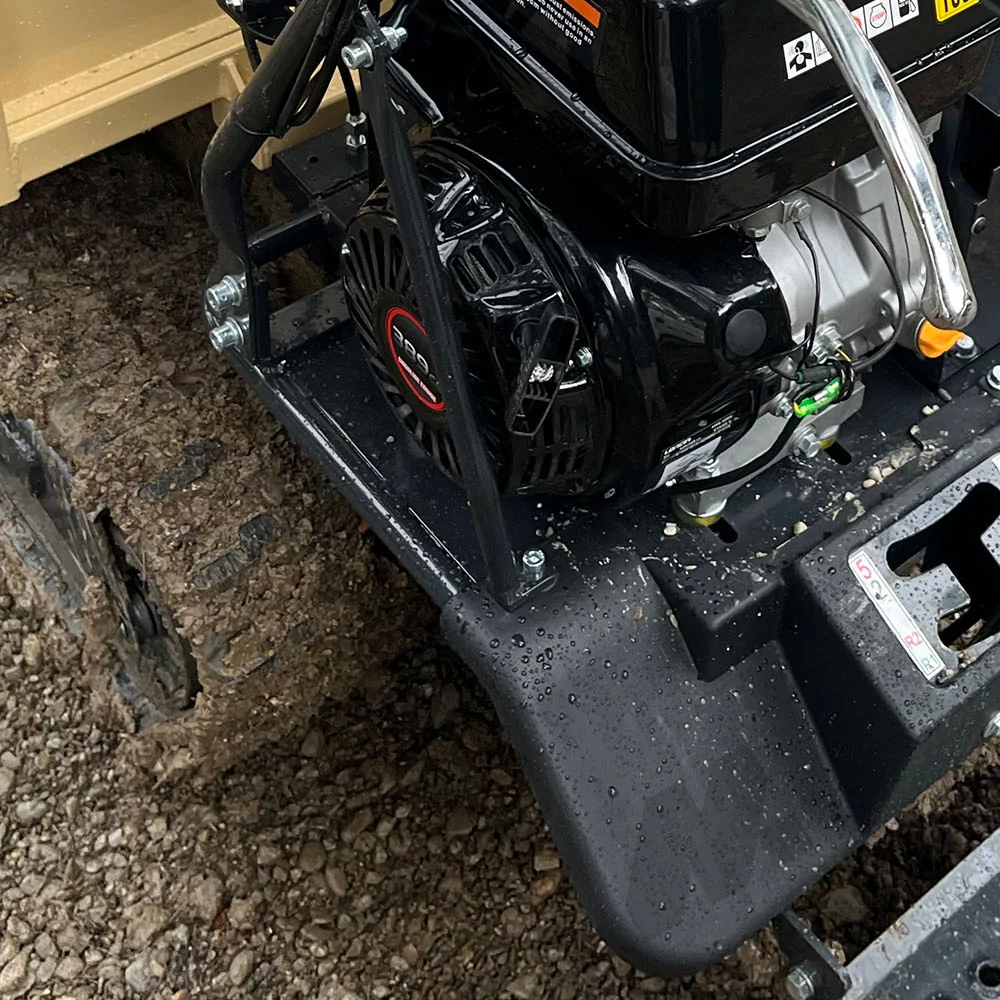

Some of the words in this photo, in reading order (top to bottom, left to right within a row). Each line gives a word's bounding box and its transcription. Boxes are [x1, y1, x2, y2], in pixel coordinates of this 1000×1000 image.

[540, 7, 565, 31] without
[564, 28, 582, 46] good
[546, 3, 564, 20] never
[564, 18, 576, 31] use
[576, 26, 584, 38] in
[583, 34, 592, 45] an
[855, 559, 873, 580] 5
[870, 580, 888, 601] 2
[904, 631, 923, 648] R2
[920, 654, 937, 670] R1
